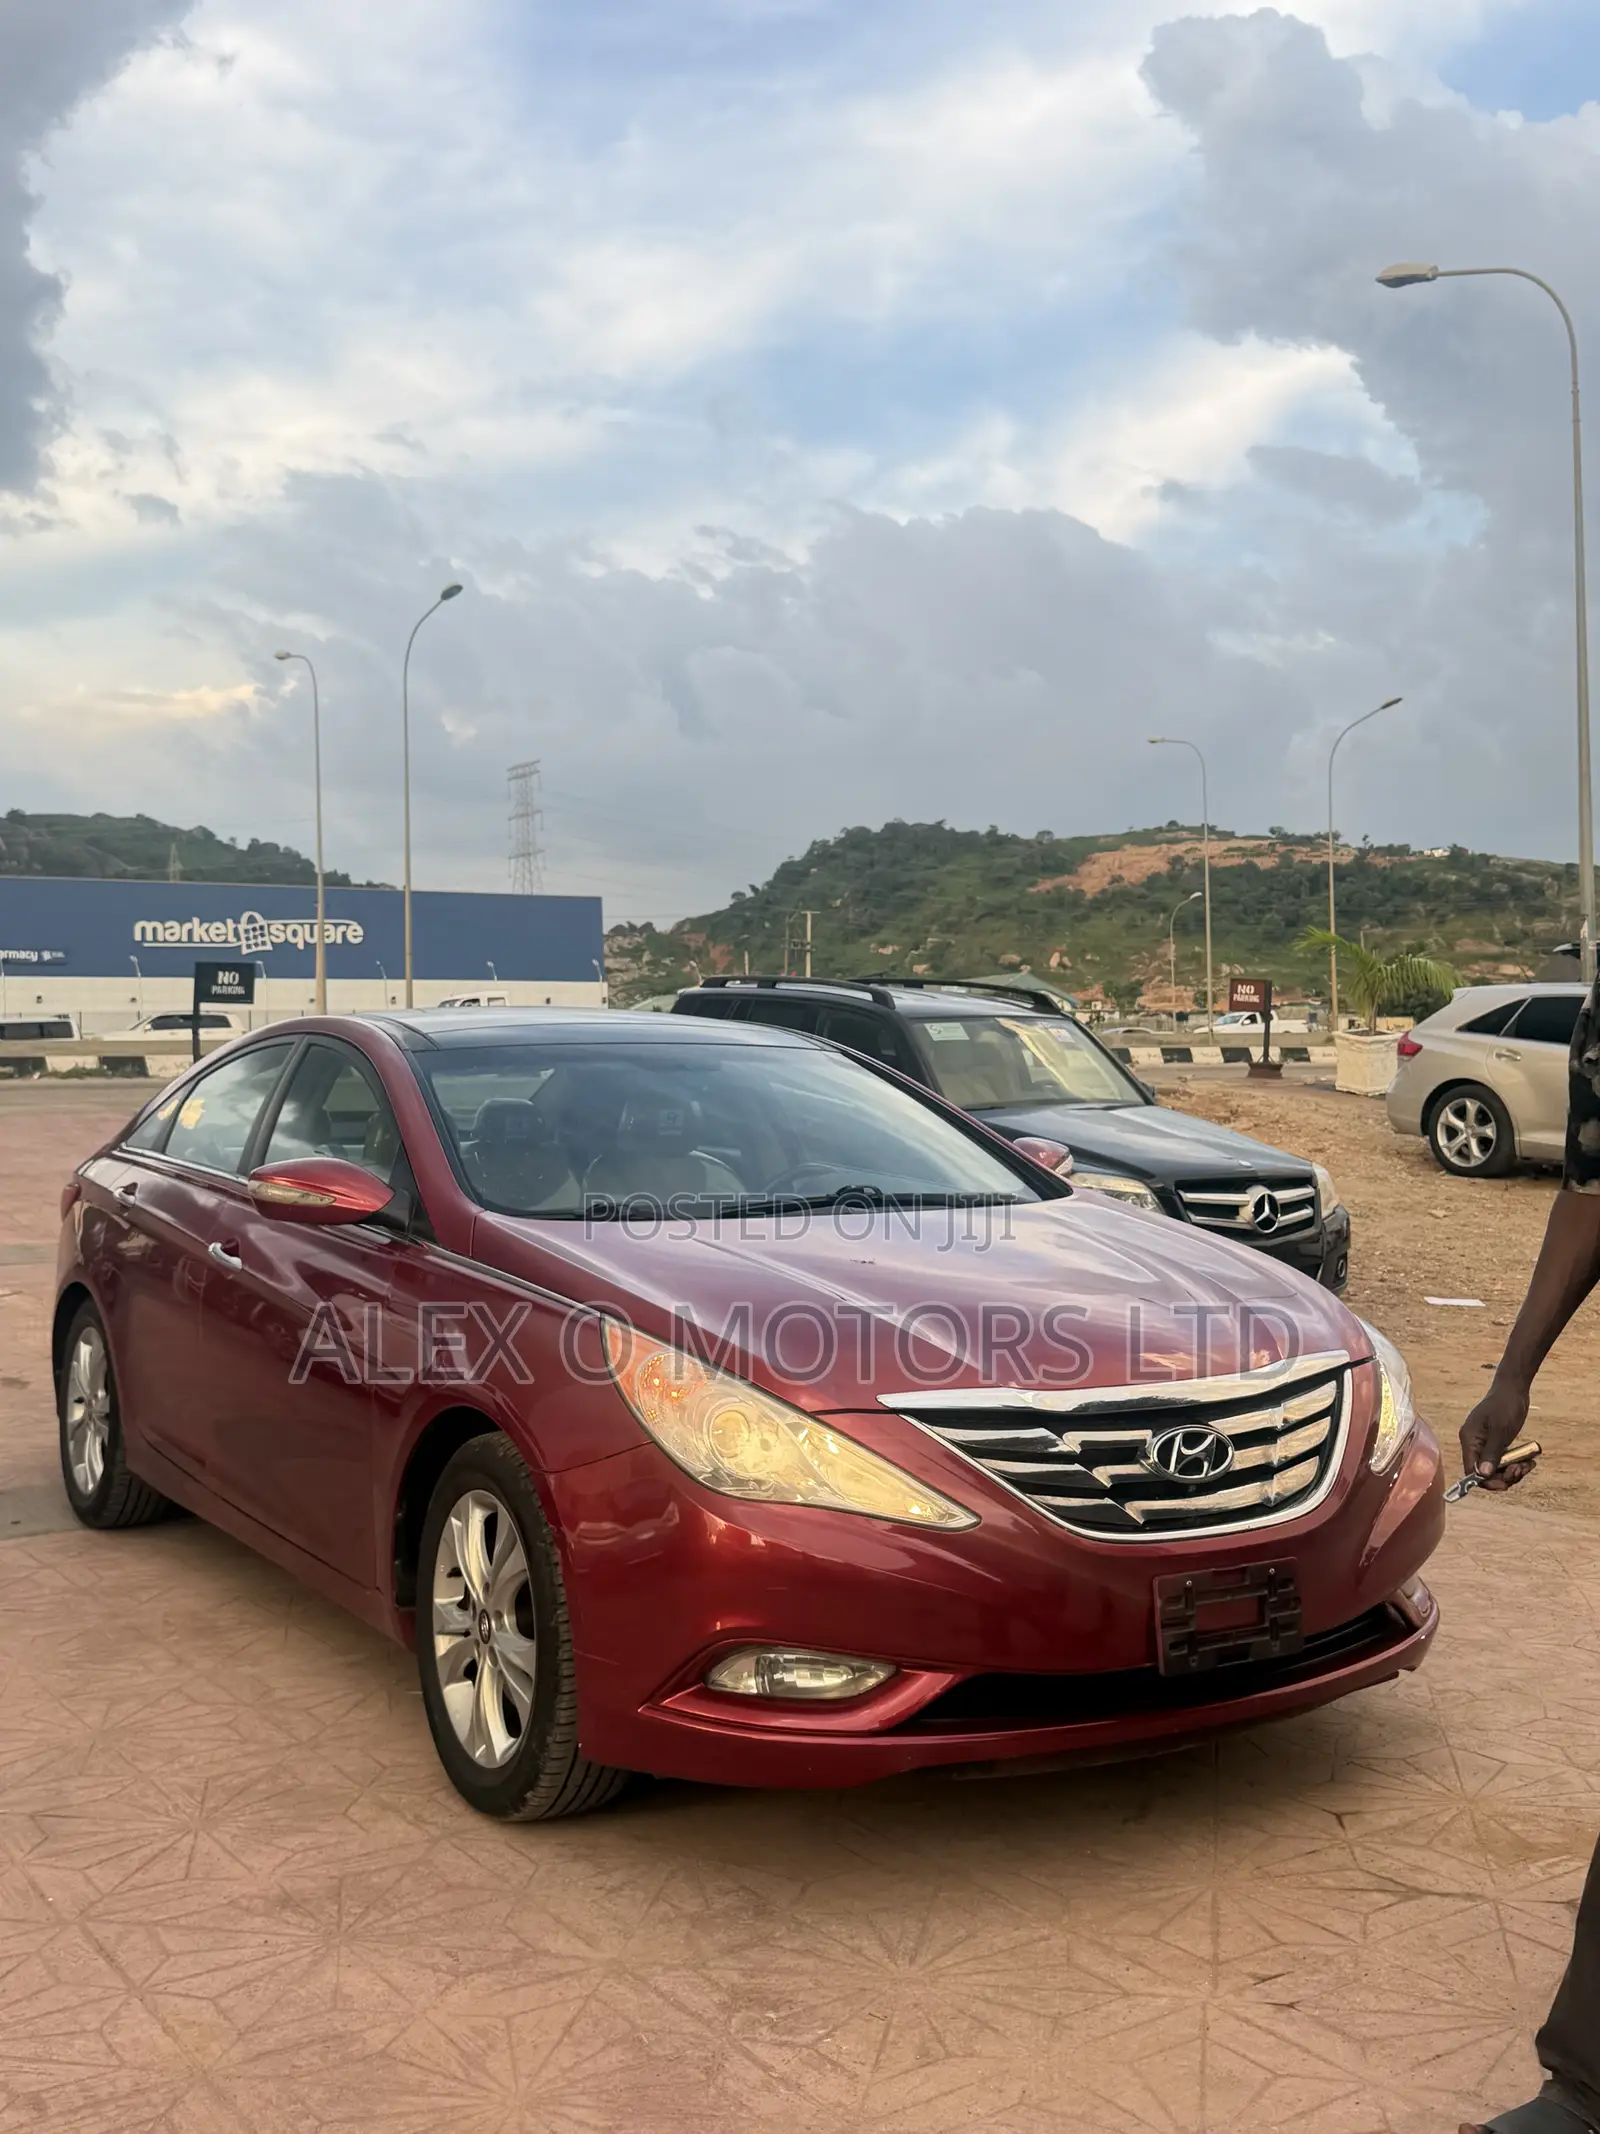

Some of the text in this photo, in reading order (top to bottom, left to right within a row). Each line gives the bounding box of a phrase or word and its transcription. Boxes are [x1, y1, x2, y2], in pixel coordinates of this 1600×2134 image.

[134, 917, 237, 943] market
[217, 970, 240, 985] NO
[211, 985, 246, 995] PARKING
[1237, 984, 1255, 995] NO
[1233, 993, 1260, 1003] PARKING
